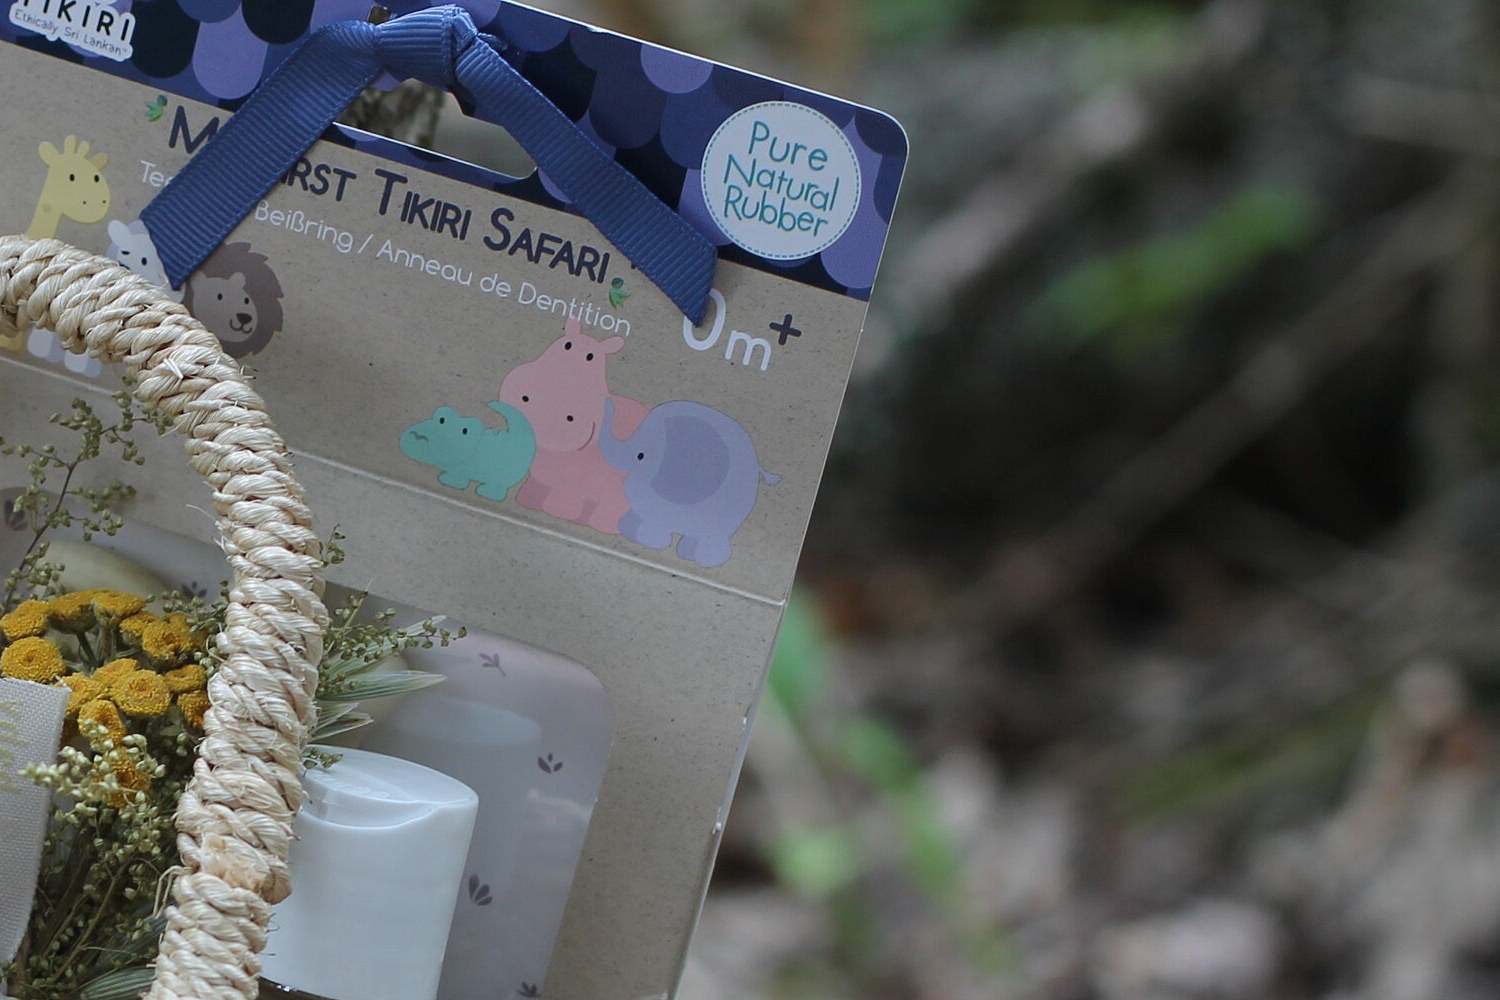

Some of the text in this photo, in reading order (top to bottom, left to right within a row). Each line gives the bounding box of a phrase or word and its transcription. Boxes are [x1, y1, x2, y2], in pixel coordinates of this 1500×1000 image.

[15, 9, 59, 35] Ethically
[64, 26, 79, 40] Sri
[748, 120, 828, 171] Pure
[169, 105, 610, 284] M RST TIKIRI SAFARI
[723, 153, 839, 212] Natural
[724, 184, 829, 237] Rubber
[255, 201, 353, 253] Beißring
[376, 239, 472, 287] Anneau
[479, 273, 512, 297] de
[518, 282, 631, 337] Dentition
